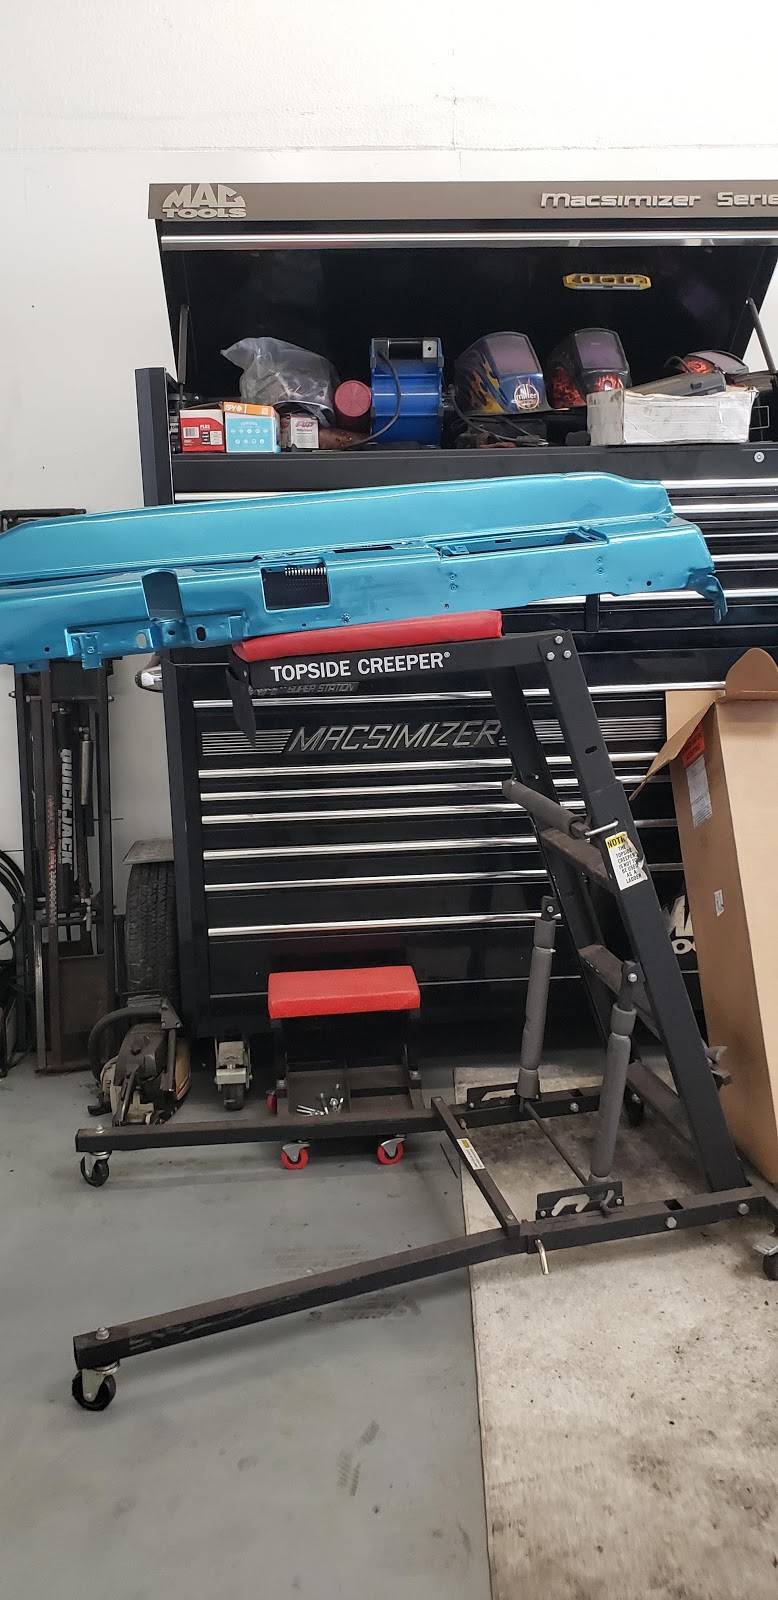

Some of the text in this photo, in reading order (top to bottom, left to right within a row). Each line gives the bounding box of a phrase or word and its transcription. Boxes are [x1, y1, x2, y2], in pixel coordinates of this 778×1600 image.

[540, 192, 701, 208] Macsimizer
[162, 207, 247, 218] TOOLS
[270, 659, 351, 682] TOPSIDE
[317, 683, 354, 693] STATION
[287, 720, 501, 750] MACSIMIZER
[60, 748, 73, 864] QUICKJACK
